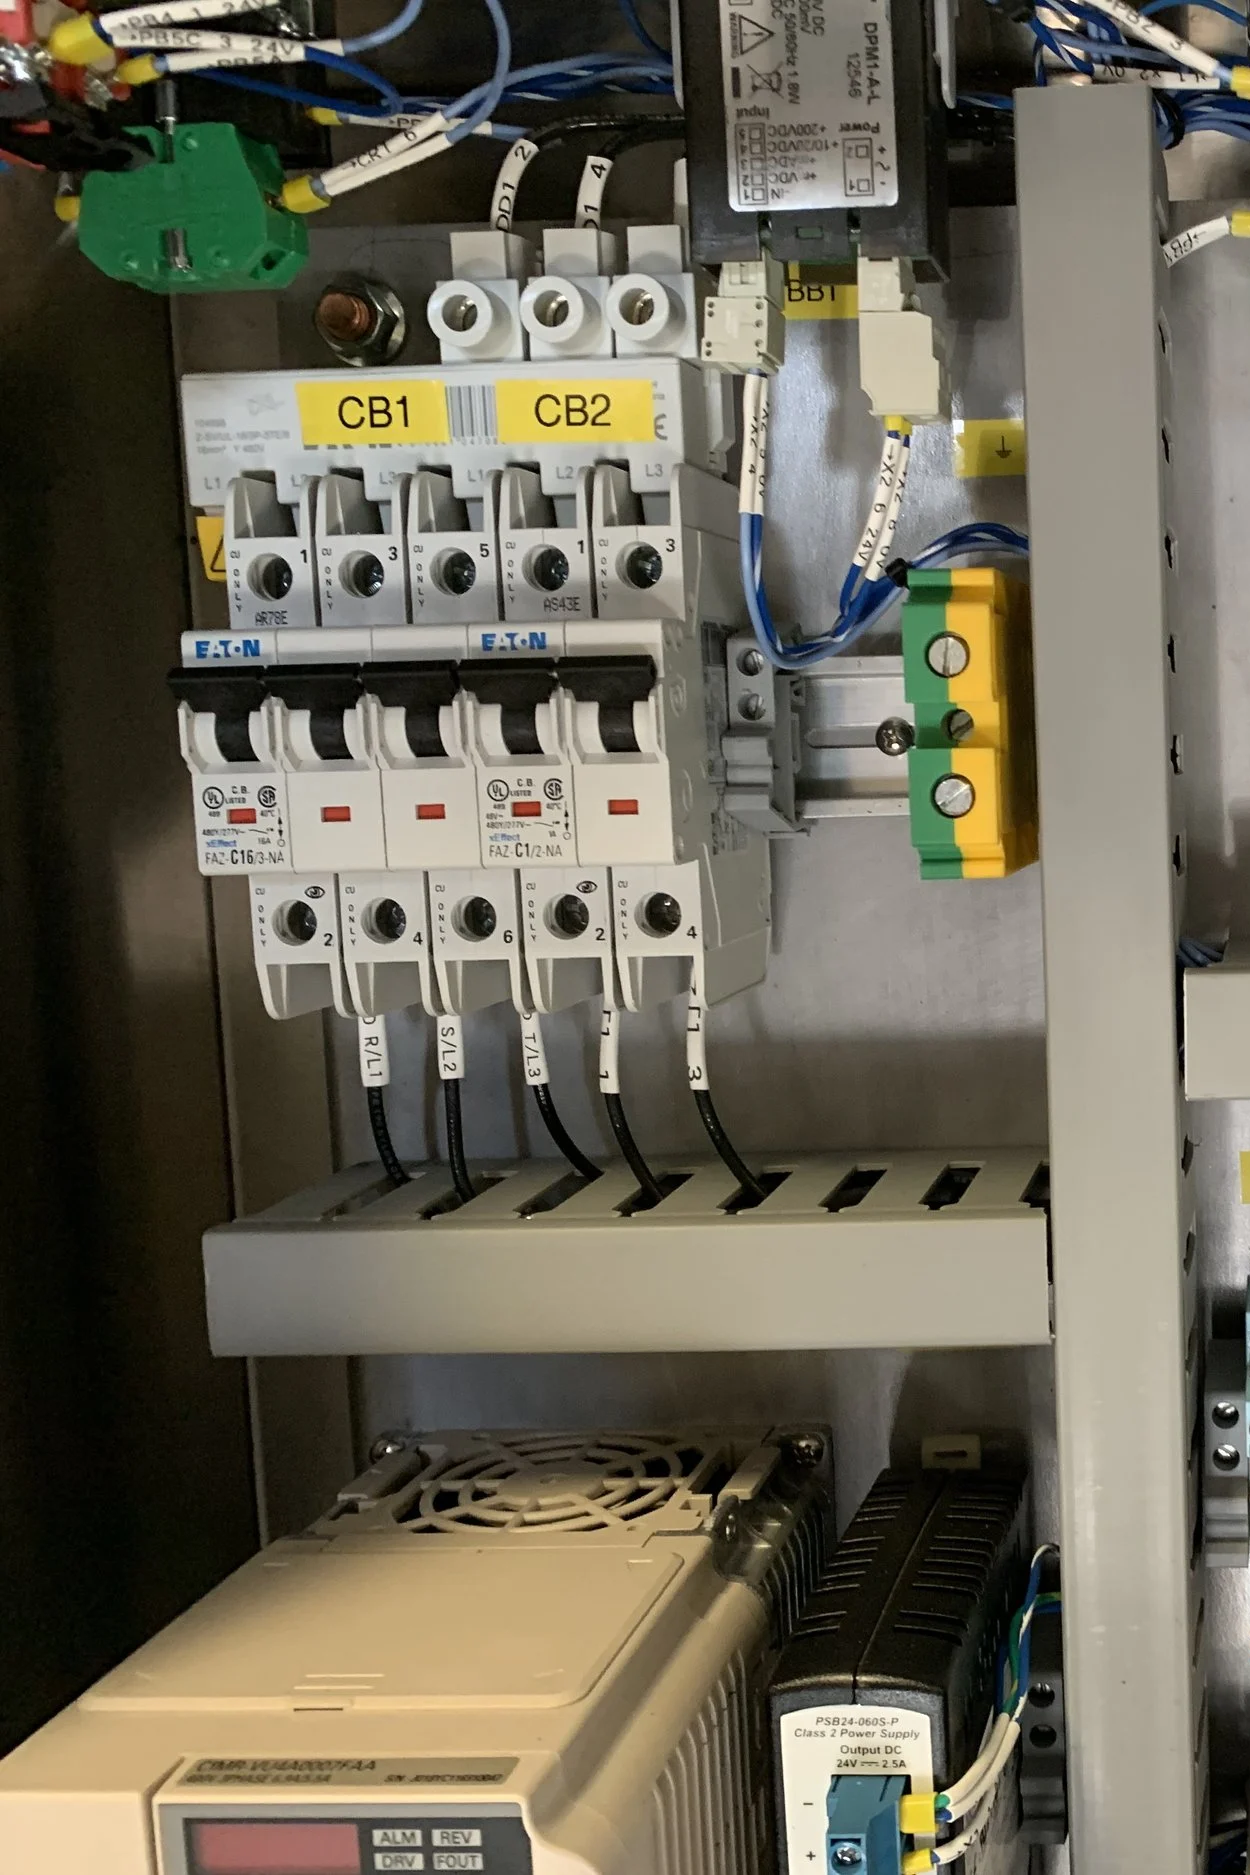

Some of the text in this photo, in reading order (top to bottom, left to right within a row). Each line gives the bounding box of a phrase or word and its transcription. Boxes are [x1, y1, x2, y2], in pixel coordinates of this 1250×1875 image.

[139, 28, 294, 54] PB5C 3 24V
[864, 22, 881, 105] DPM1-A-L
[846, 52, 861, 98] 12546
[736, 105, 770, 120] Input
[839, 122, 880, 133] Power
[591, 163, 606, 179] 4
[338, 395, 409, 429] CB1
[534, 393, 612, 427] CB2
[468, 469, 484, 482] L1
[556, 466, 574, 479] L2
[645, 464, 663, 477] L3
[205, 477, 221, 490] L1
[858, 460, 896, 562] X2 6 24V
[480, 544, 490, 558] 5
[577, 540, 584, 553] 1
[666, 539, 675, 552] 3
[300, 549, 307, 563] 1
[389, 547, 398, 561] 3
[544, 597, 581, 612] AS43E
[205, 849, 284, 866] FAZ-C16/3-NA
[489, 843, 562, 858] FAZ-C1/2-NA
[413, 932, 423, 945] 4
[503, 930, 513, 943] 6
[596, 928, 606, 941] 2
[687, 926, 697, 939] 4
[324, 933, 333, 947] 2
[441, 1027, 458, 1072] S/L2
[524, 1033, 542, 1078] T/L3
[364, 1036, 383, 1078] R/L1
[687, 1066, 702, 1081] 3
[815, 1717, 899, 1727] PSB24-060S-P
[794, 1729, 920, 1740] Class 2 Power Supply
[840, 1745, 902, 1755] Output DC
[837, 1760, 906, 1768] 24V 2.5A
[380, 1831, 472, 1844] ALM REV
[382, 1855, 477, 1868] DRV FOUT
